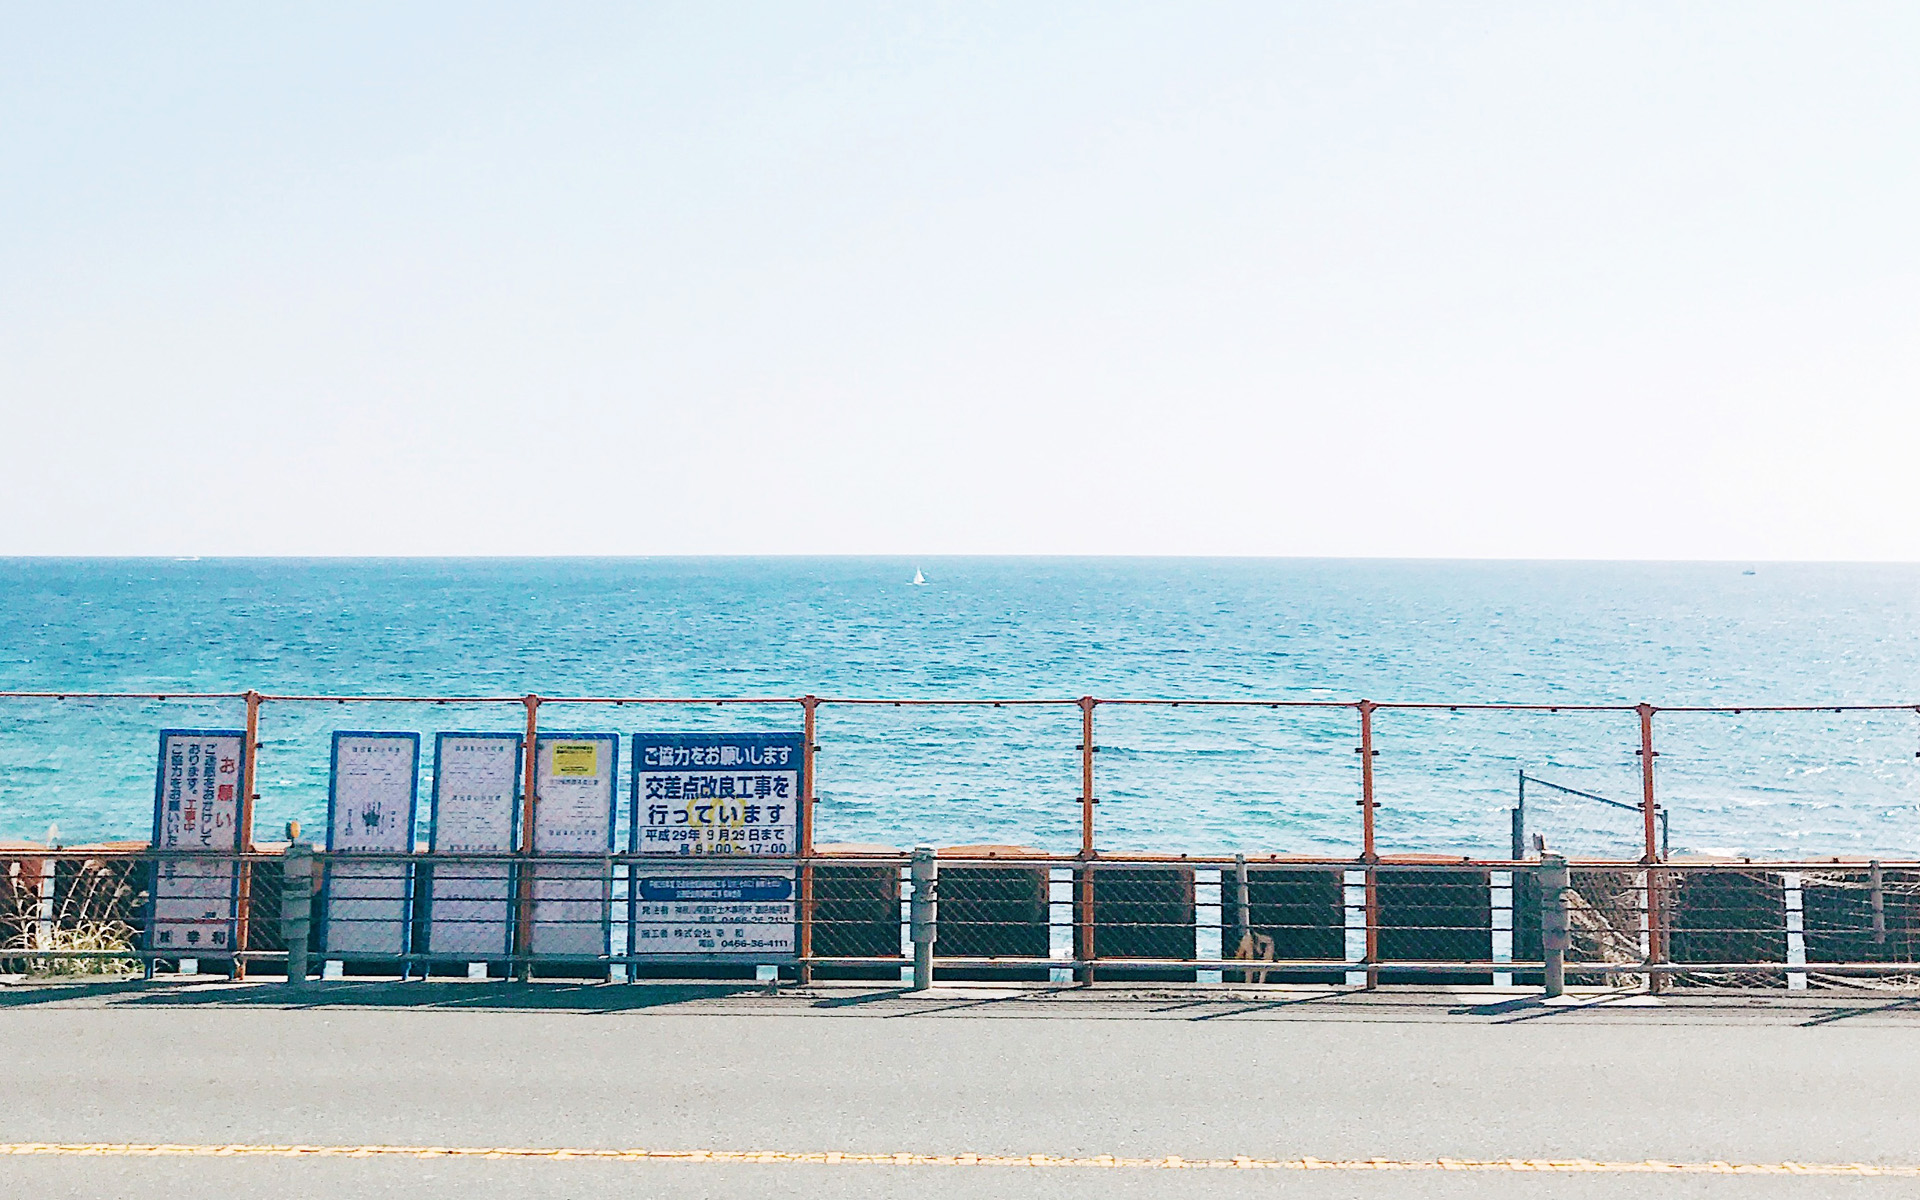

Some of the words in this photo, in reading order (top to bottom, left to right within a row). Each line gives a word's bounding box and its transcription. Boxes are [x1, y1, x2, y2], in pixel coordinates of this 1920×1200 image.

[644, 746, 793, 766] ご協力をお願いします
[216, 756, 235, 828] お願い
[645, 775, 790, 800] 交差点改良工事を
[648, 804, 786, 825] 行っています
